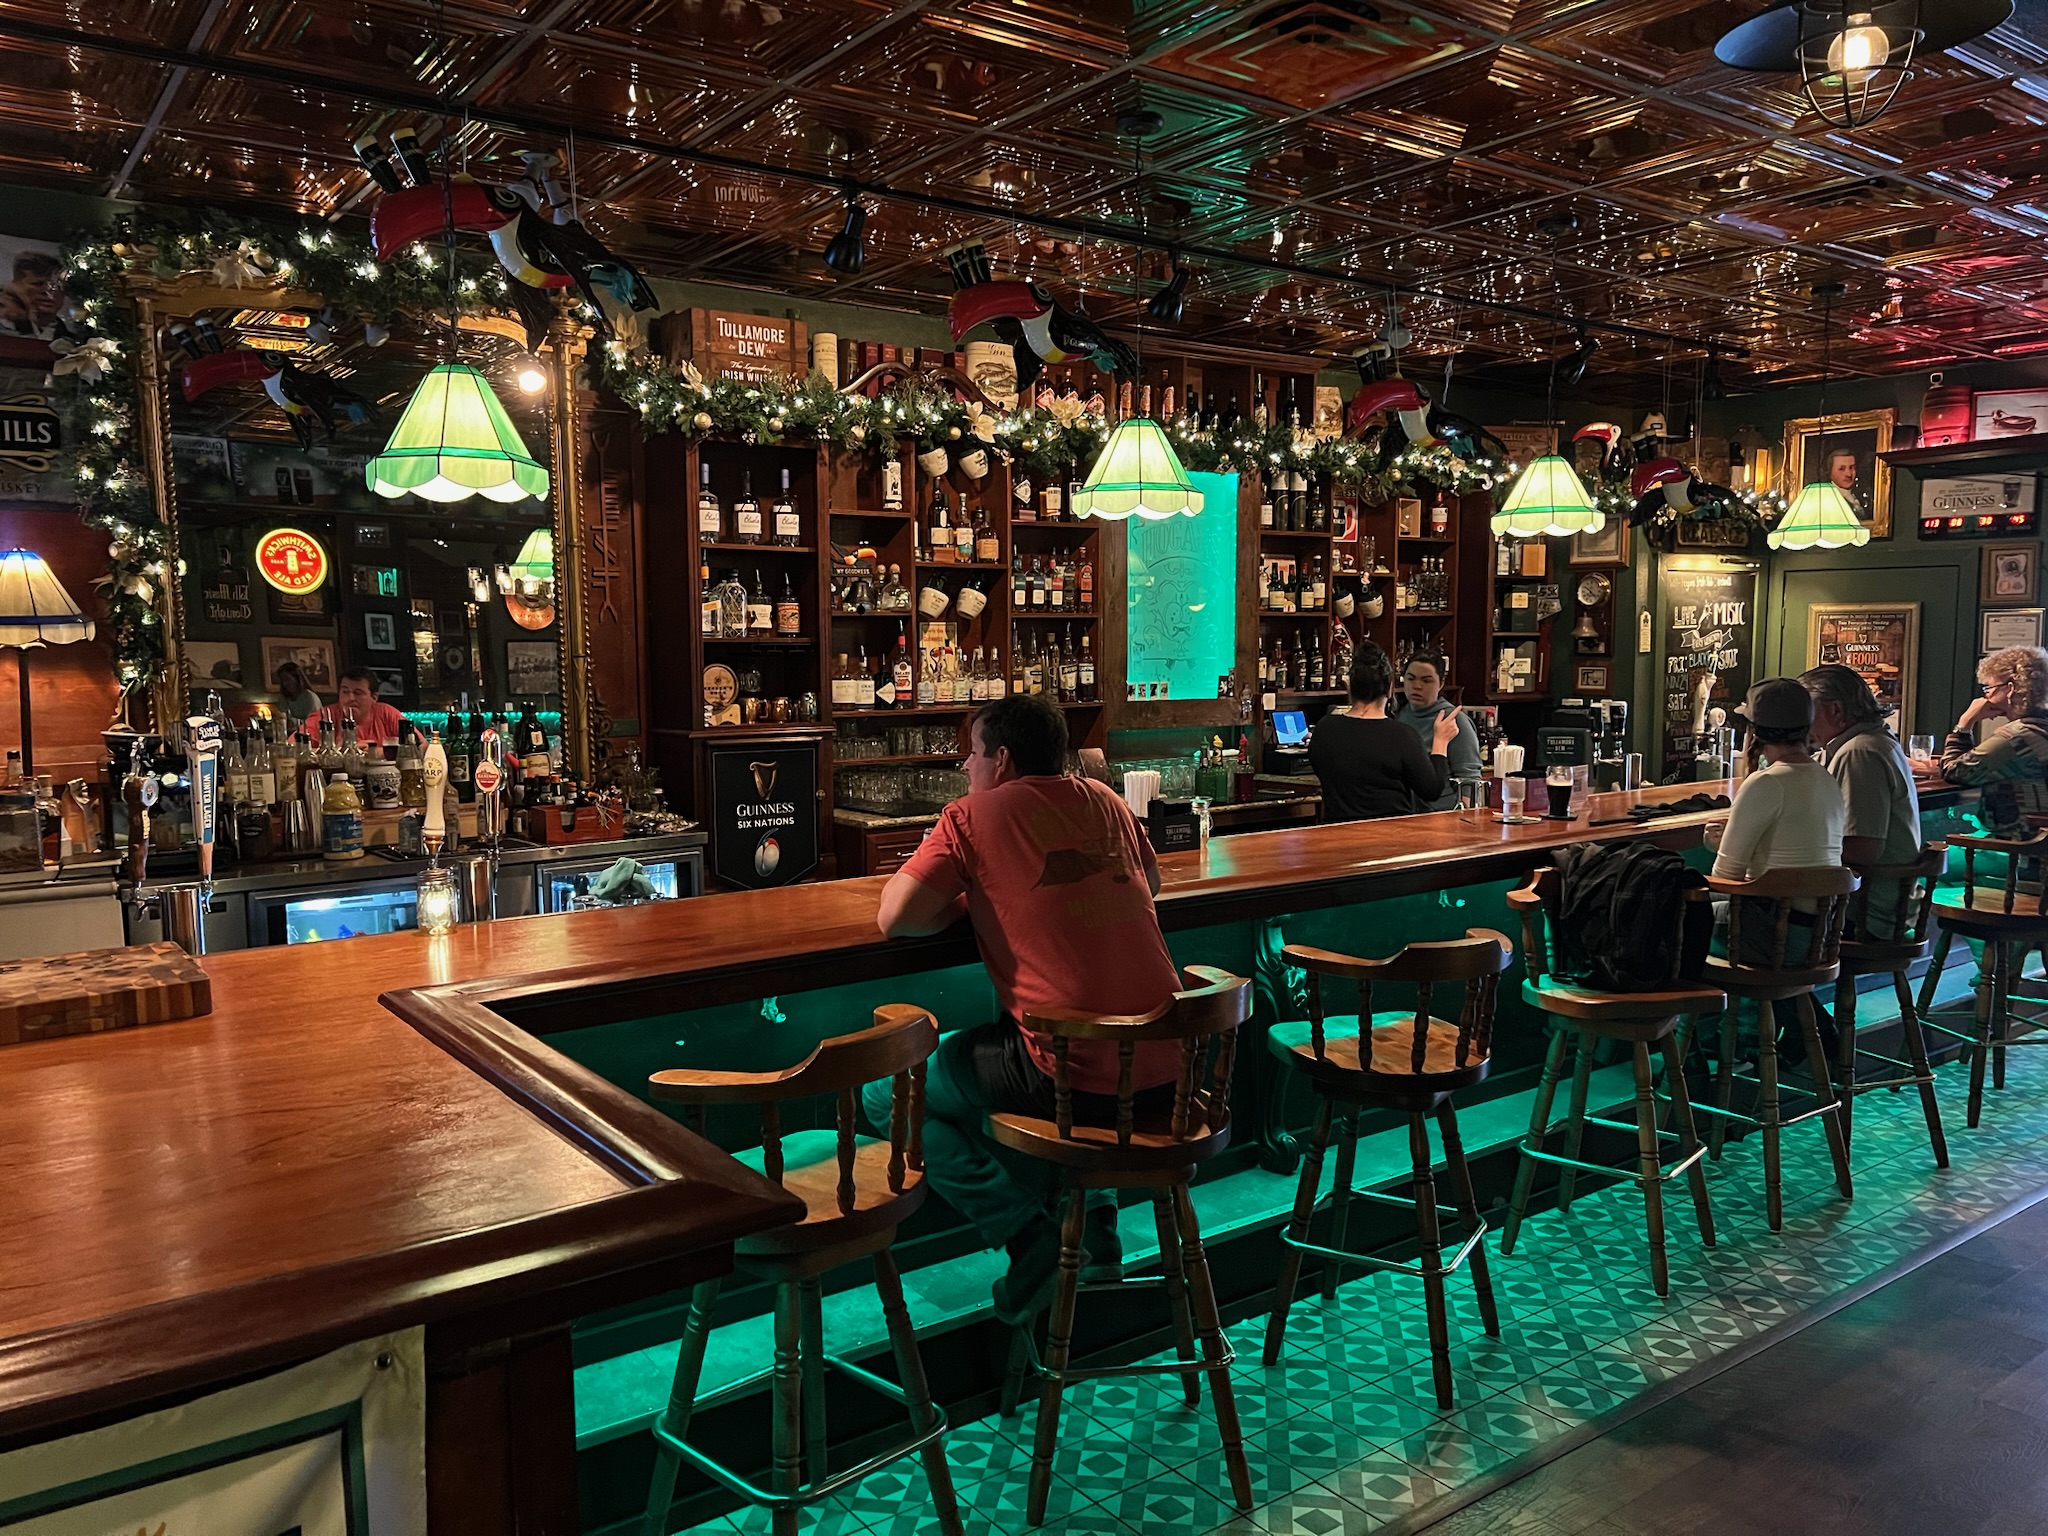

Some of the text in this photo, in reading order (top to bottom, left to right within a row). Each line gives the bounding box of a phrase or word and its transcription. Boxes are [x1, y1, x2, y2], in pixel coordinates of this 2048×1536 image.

[716, 317, 786, 344] TULLAMORE
[721, 369, 744, 381] IRISH
[0, 419, 52, 444] ILLS
[1933, 494, 1996, 509] GUINNESS
[1141, 520, 1201, 567] HOGA
[1674, 601, 1746, 626] LIVE MUSIC
[1845, 643, 1880, 652] GUINNESS
[1852, 652, 1878, 665] FOOD
[202, 773, 212, 829] WINTER LAGER
[736, 802, 795, 817] GUINNESS
[737, 816, 795, 830] SIX NATIONS
